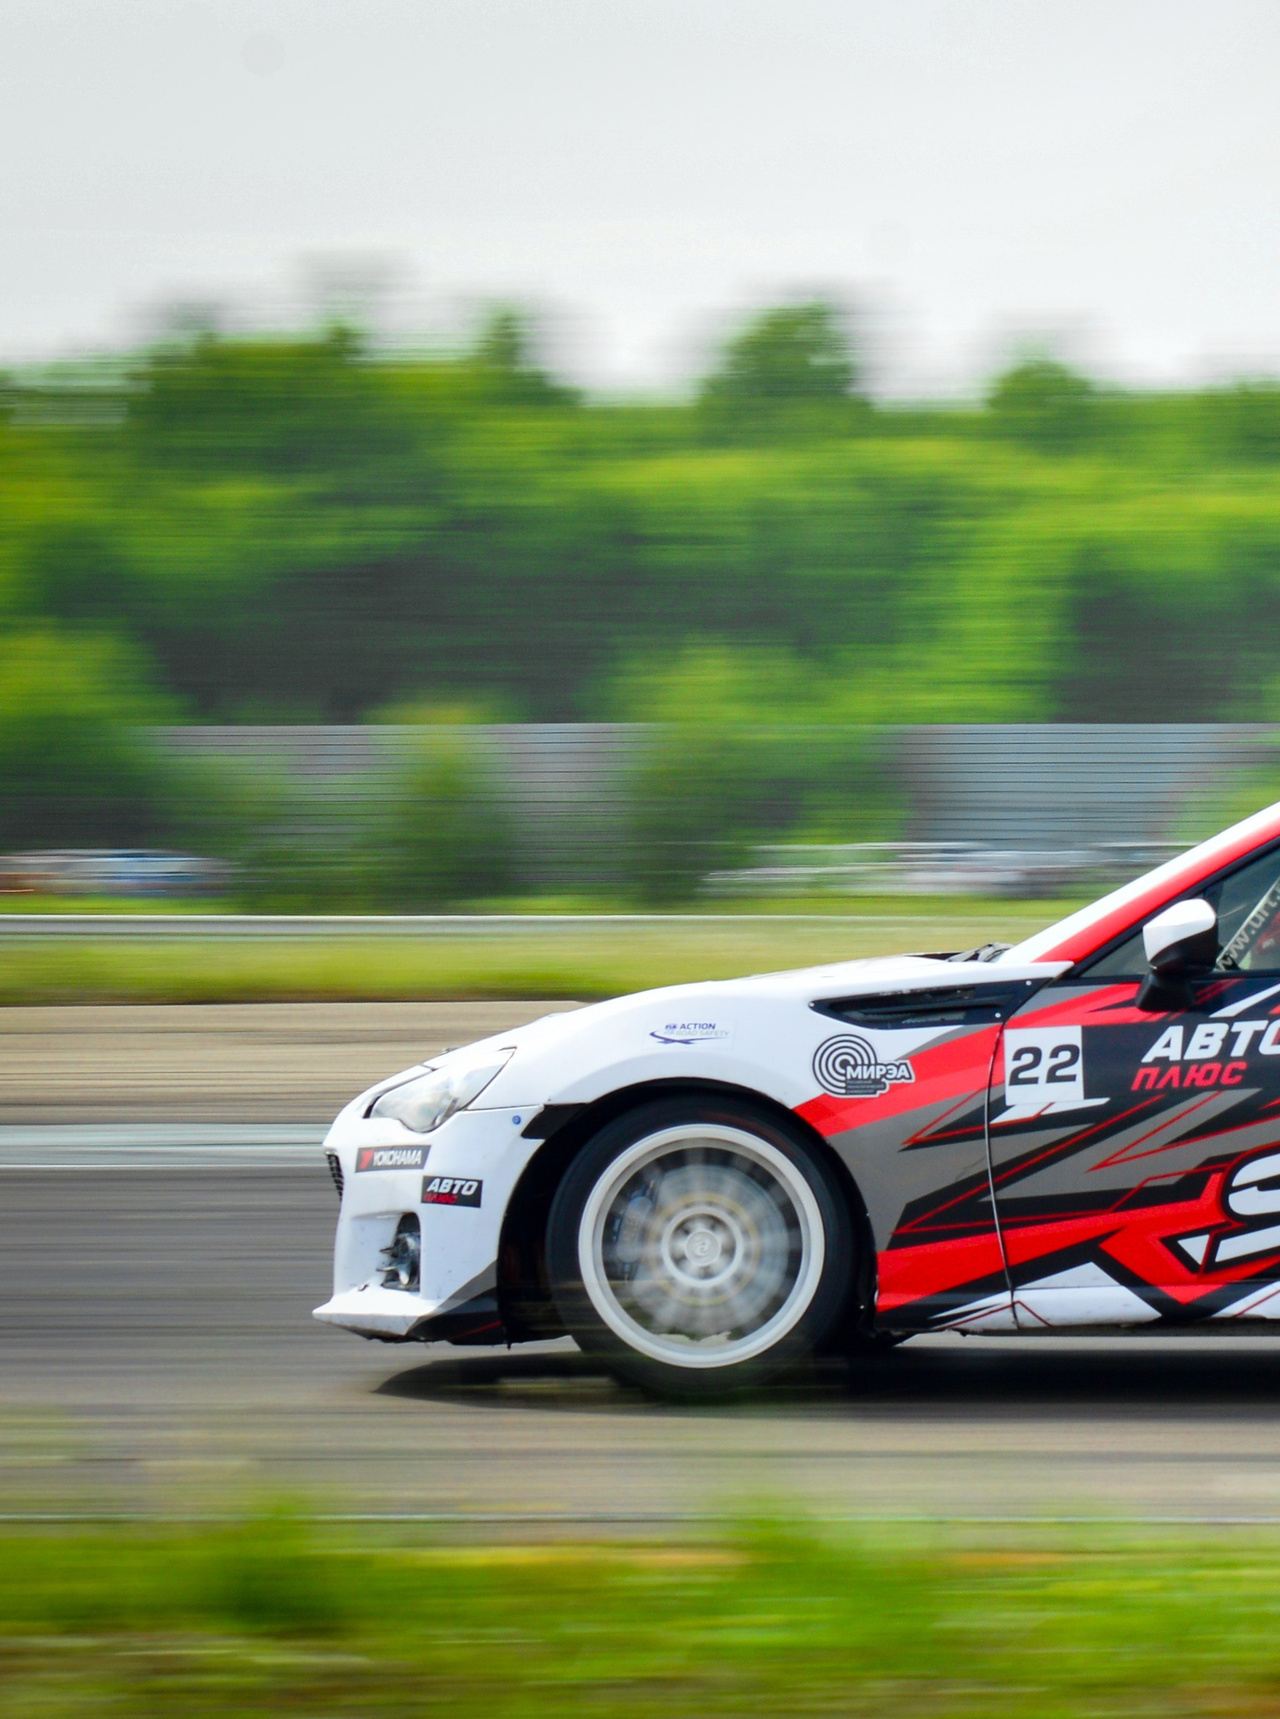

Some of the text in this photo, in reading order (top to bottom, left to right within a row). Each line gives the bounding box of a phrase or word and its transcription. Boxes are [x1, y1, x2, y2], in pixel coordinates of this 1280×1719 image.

[680, 1022, 717, 1030] ACTION
[846, 1064, 911, 1080] МИРЭА
[1008, 1043, 1080, 1087] 22
[1130, 1060, 1248, 1092] ПЛЮС
[373, 1149, 422, 1167] YOKOHAMA
[426, 1177, 479, 1196] АВТО
